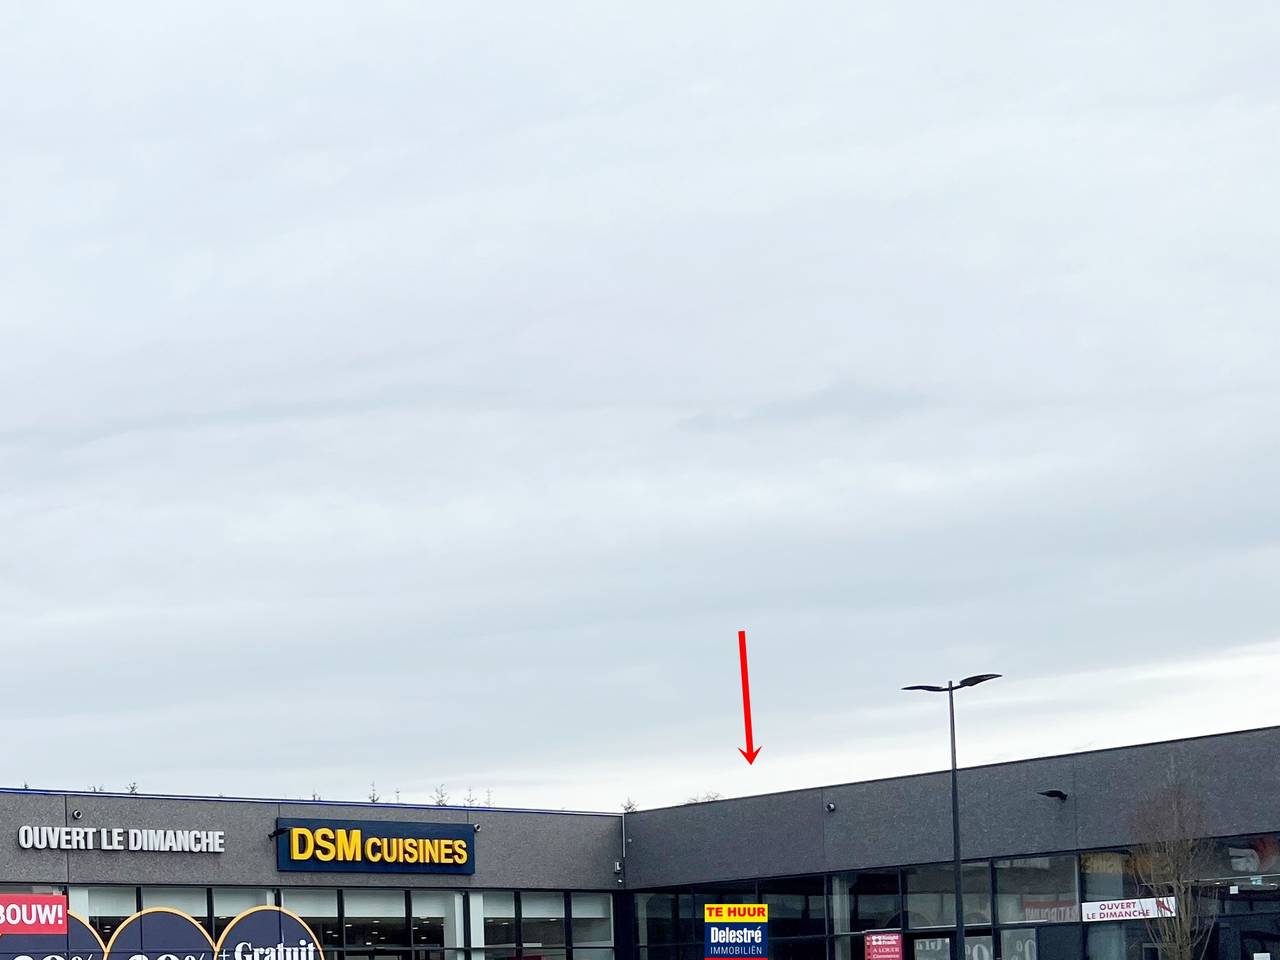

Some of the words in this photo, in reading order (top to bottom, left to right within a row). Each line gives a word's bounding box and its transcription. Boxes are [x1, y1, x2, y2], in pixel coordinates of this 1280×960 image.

[18, 825, 97, 850] OUVERT
[101, 828, 124, 850] LE
[128, 829, 225, 853] DIMANCHE
[291, 827, 362, 862] DSM
[365, 837, 468, 865] CUISINES
[1086, 912, 1096, 920] LE
[1099, 909, 1151, 919] DIMANCHE
[1099, 901, 1137, 911] OUVERT
